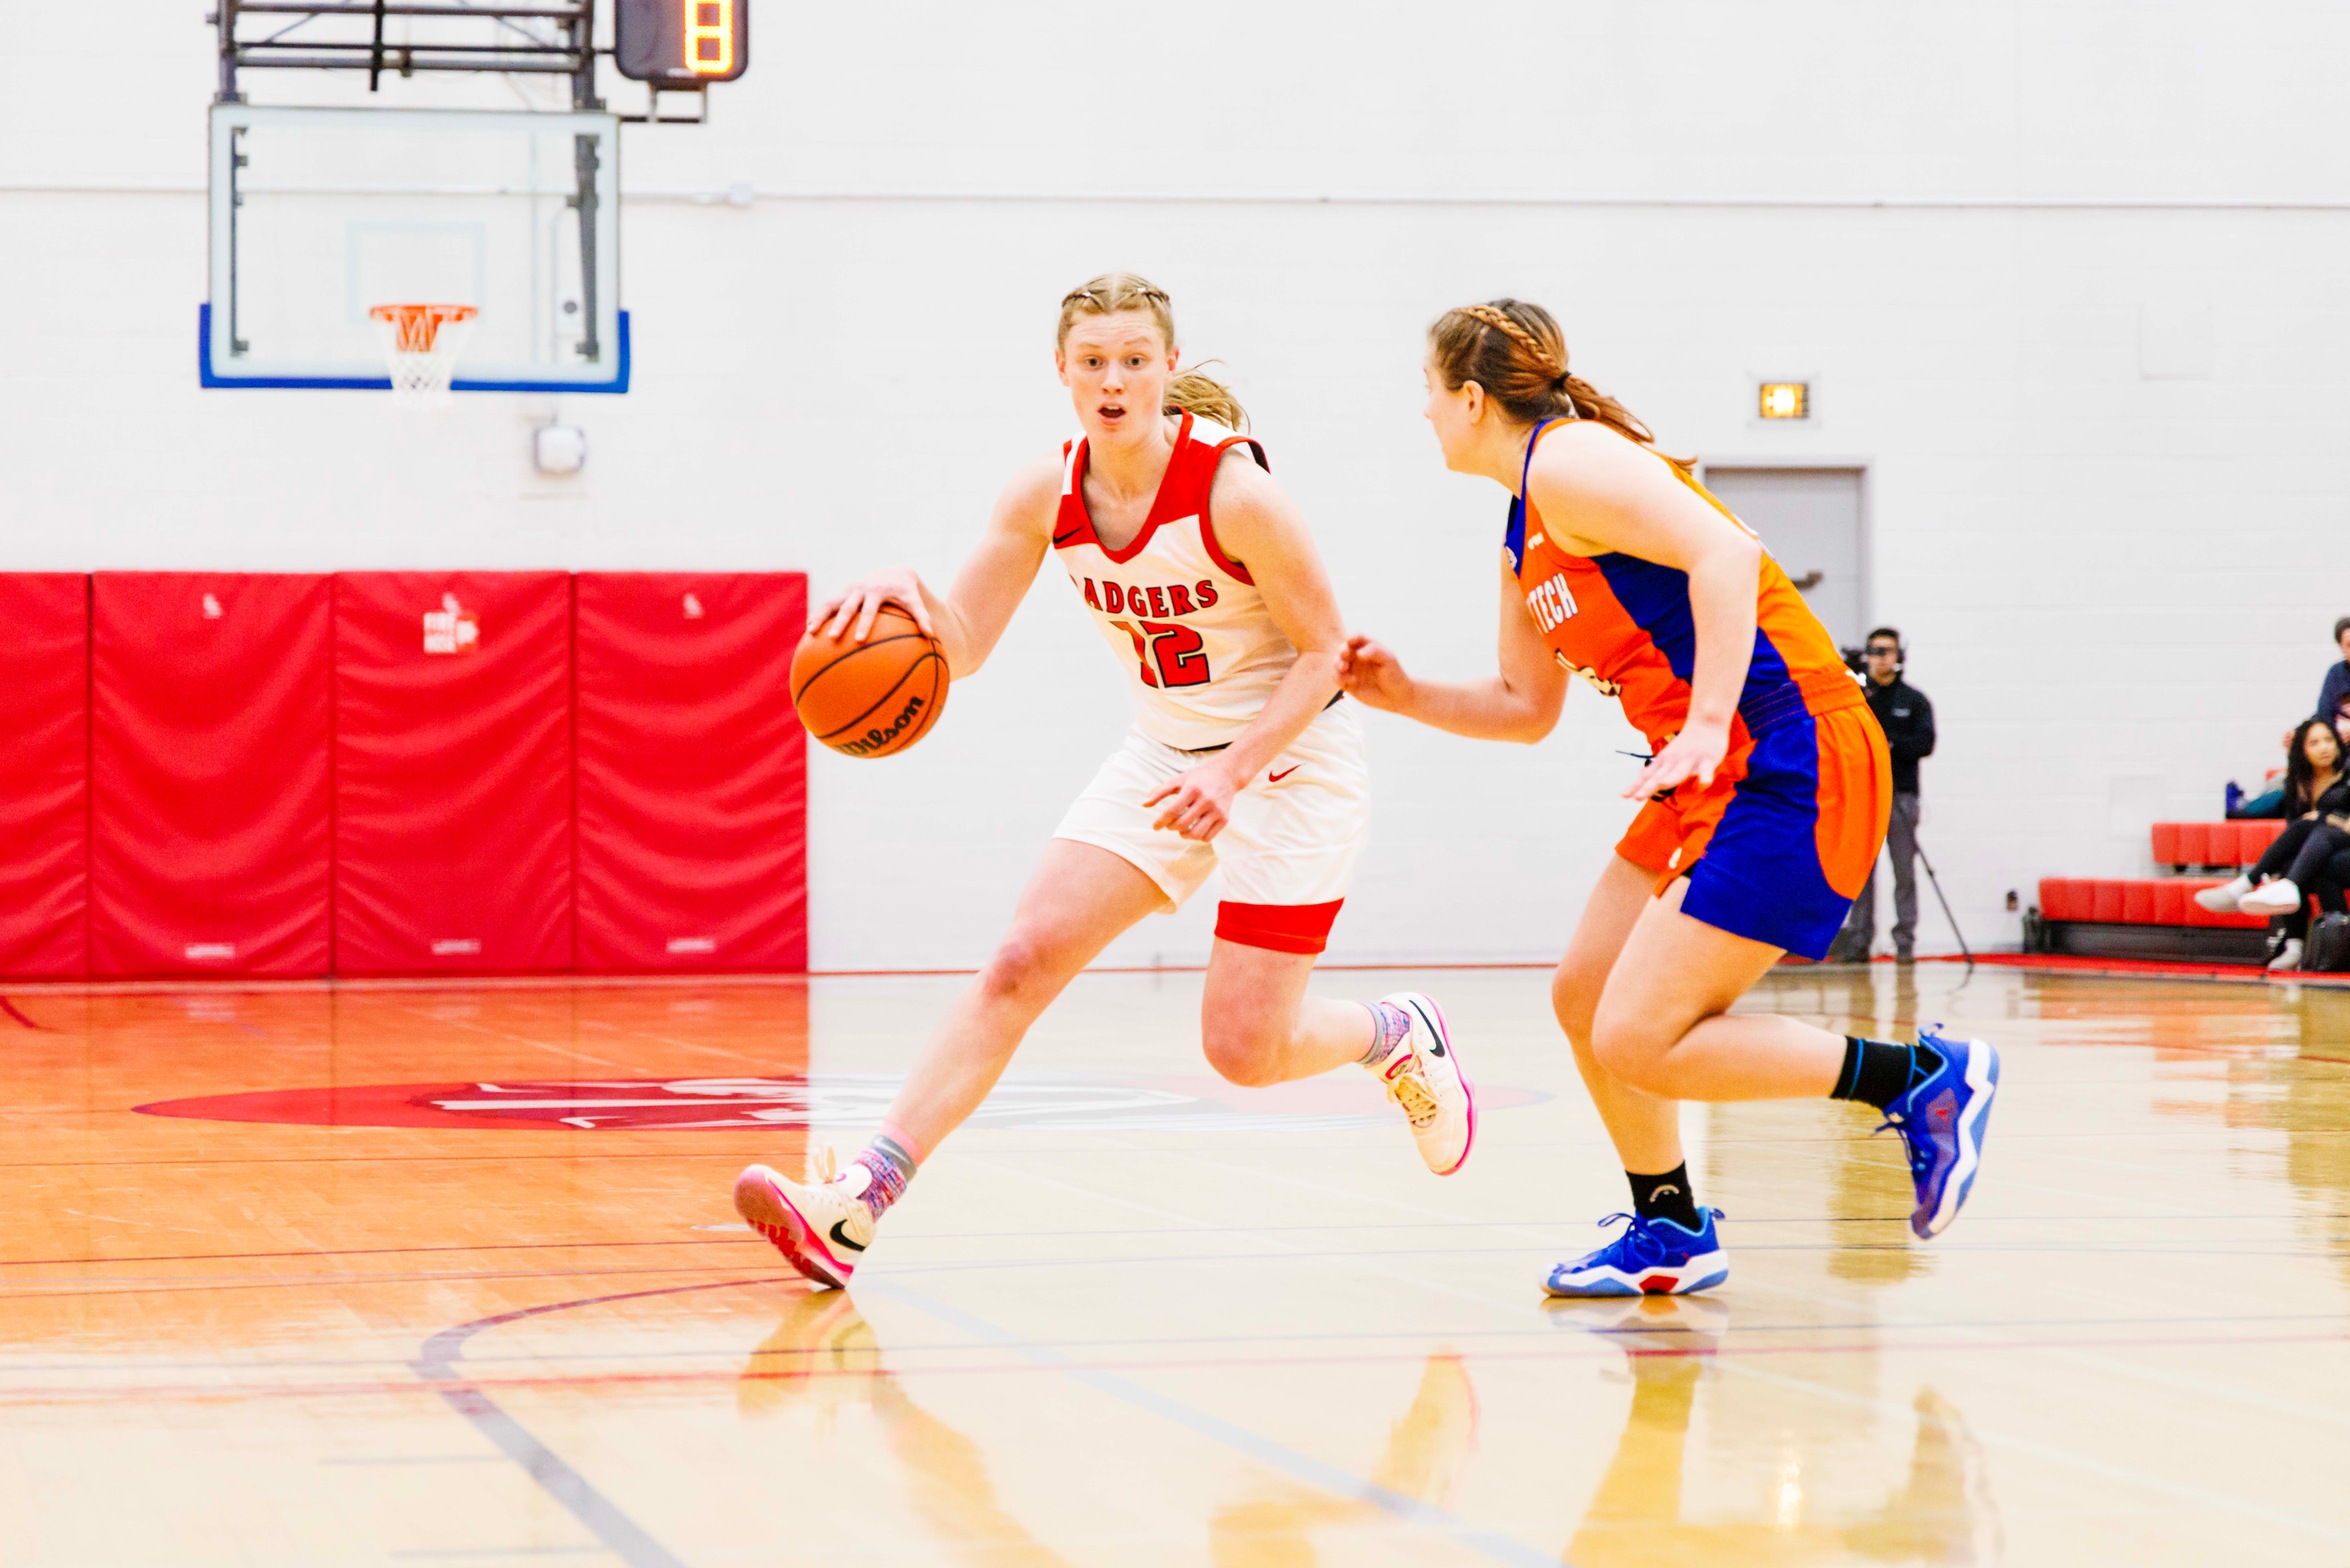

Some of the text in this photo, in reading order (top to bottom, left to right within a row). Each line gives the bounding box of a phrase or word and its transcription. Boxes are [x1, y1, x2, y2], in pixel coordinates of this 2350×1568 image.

[684, 0, 734, 74] 8
[1069, 573, 1218, 618] ADGERS
[1108, 620, 1211, 688] 12
